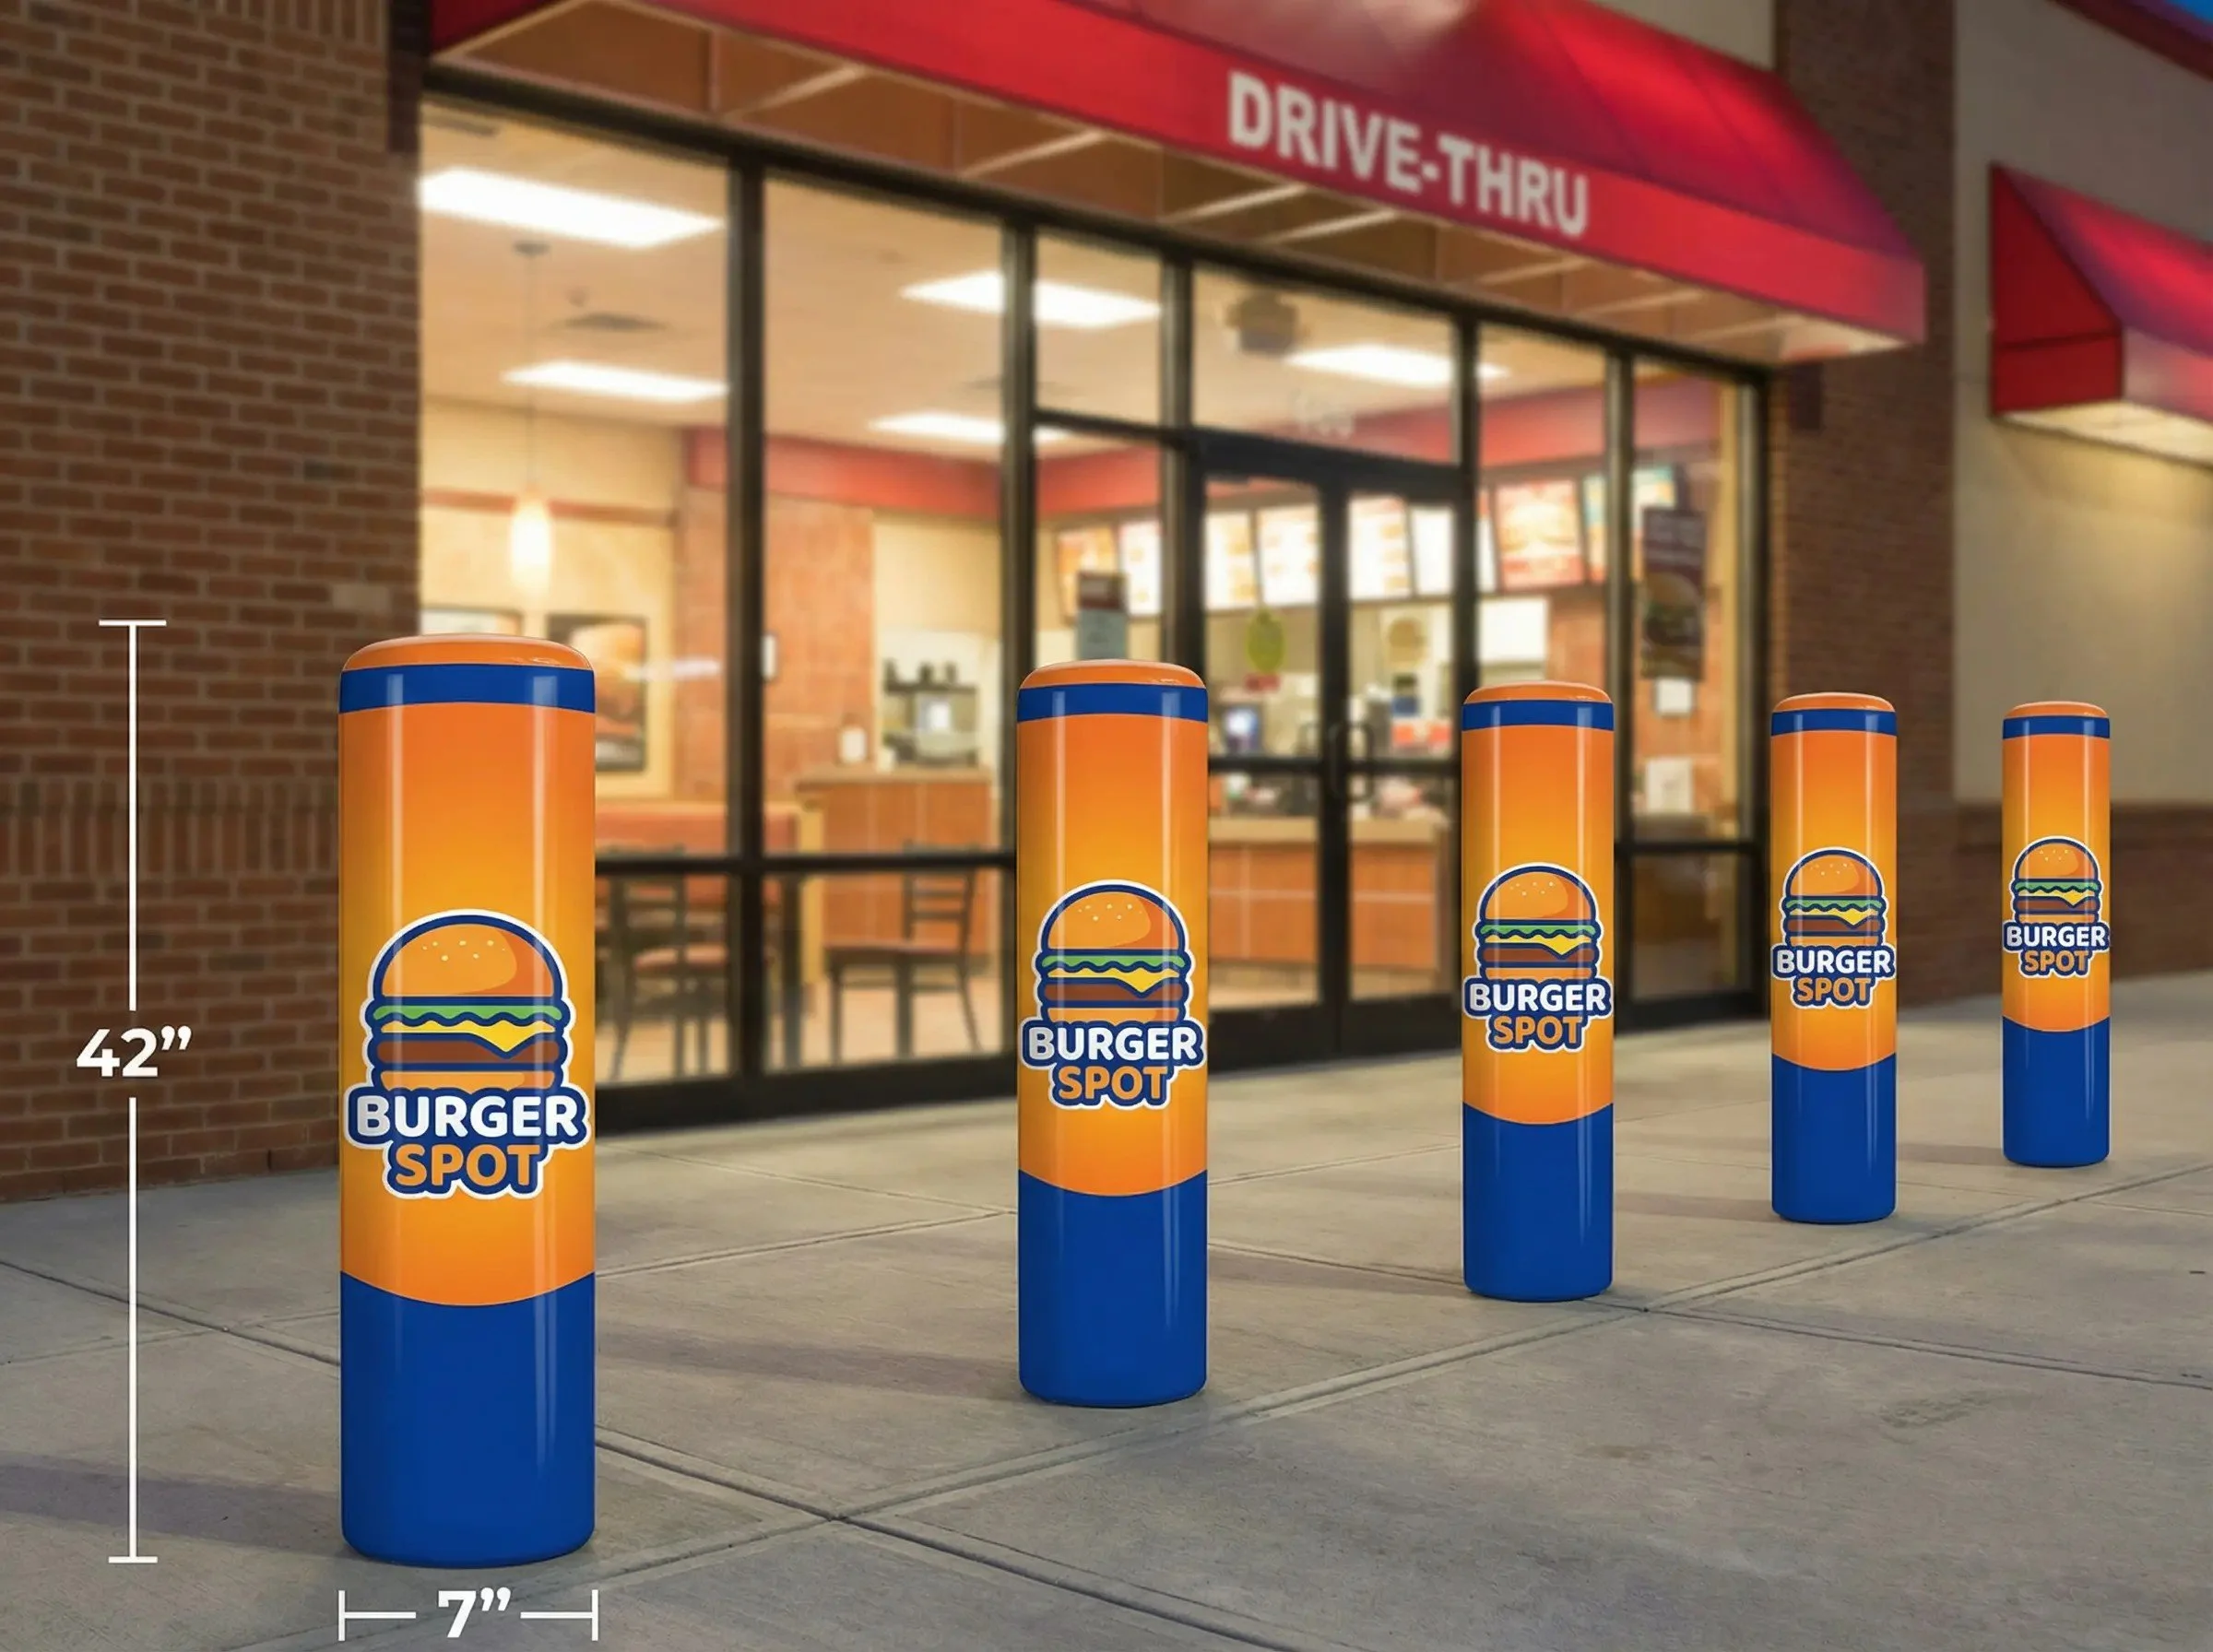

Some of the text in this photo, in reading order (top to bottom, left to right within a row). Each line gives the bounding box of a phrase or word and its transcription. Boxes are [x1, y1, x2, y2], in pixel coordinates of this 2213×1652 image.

[1229, 70, 1588, 238] DRIVE-THRU
[2006, 926, 2105, 948] BURGER
[1777, 950, 1891, 974] BURGER
[2024, 950, 2089, 972] SPOT
[1470, 984, 1606, 1011] BURGER
[1797, 977, 1871, 1002] SPOT
[1028, 1027, 1197, 1061] BURGER
[1494, 1016, 1582, 1044] SPOT
[1059, 1066, 1167, 1100] SPOT
[357, 1095, 579, 1138] BURGER
[396, 1144, 541, 1186] SPOT
